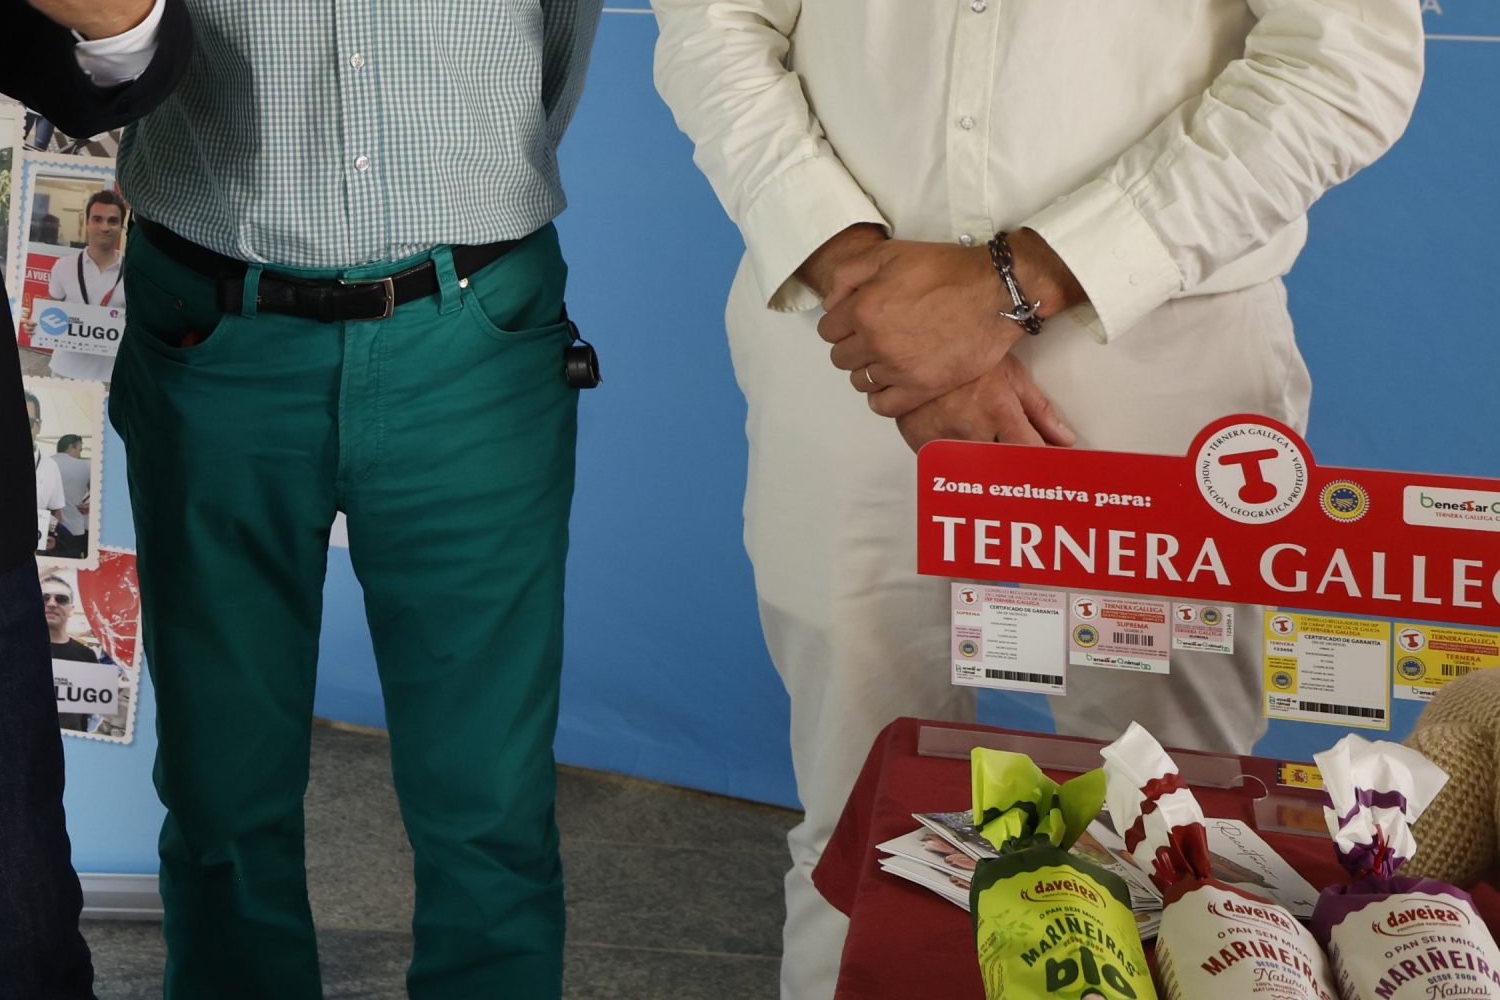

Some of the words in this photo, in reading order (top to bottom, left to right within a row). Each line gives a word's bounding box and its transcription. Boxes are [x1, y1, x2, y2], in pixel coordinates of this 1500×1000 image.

[67, 323, 119, 341] LUGO
[1209, 428, 1246, 451] TERNERA
[1248, 428, 1289, 449] GALLEGA
[932, 477, 983, 495] Zona
[989, 483, 1089, 503] exclusiva
[1094, 490, 1152, 507] para:
[1202, 460, 1229, 510] INDICACIÓN
[1230, 502, 1291, 518] GEOGRÁFICA
[1287, 456, 1304, 503] PROTEGIDA
[932, 515, 1232, 586] TERNERA
[1259, 543, 1500, 609] GALLE
[1104, 603, 1132, 611] TERNERA
[1133, 605, 1164, 614] GALLEGA
[1116, 621, 1149, 630] SUPREMA
[1304, 634, 1341, 642] CERTIFICADO
[1431, 633, 1462, 643] TERNERA
[1463, 637, 1496, 645] GALLEGA
[1446, 653, 1481, 662] TERNERA
[55, 686, 113, 704] LUGO
[1034, 879, 1099, 903] daveiga
[1046, 907, 1063, 916] PAN
[1064, 906, 1081, 914] SEN
[1223, 899, 1292, 930] daveiga
[1386, 905, 1459, 928] daveiga
[1217, 931, 1226, 940] O
[1227, 927, 1252, 935] PAN
[1254, 929, 1278, 941] SEN
[1021, 913, 1136, 977] MARIÑEIRAS
[1384, 951, 1393, 959] O
[1394, 940, 1419, 953] PAN
[1420, 935, 1447, 944] SEN
[1045, 946, 1138, 1000] bio
[1253, 968, 1309, 996] Natural
[1427, 974, 1452, 985] DESDE
[1425, 982, 1490, 1000] Natural
